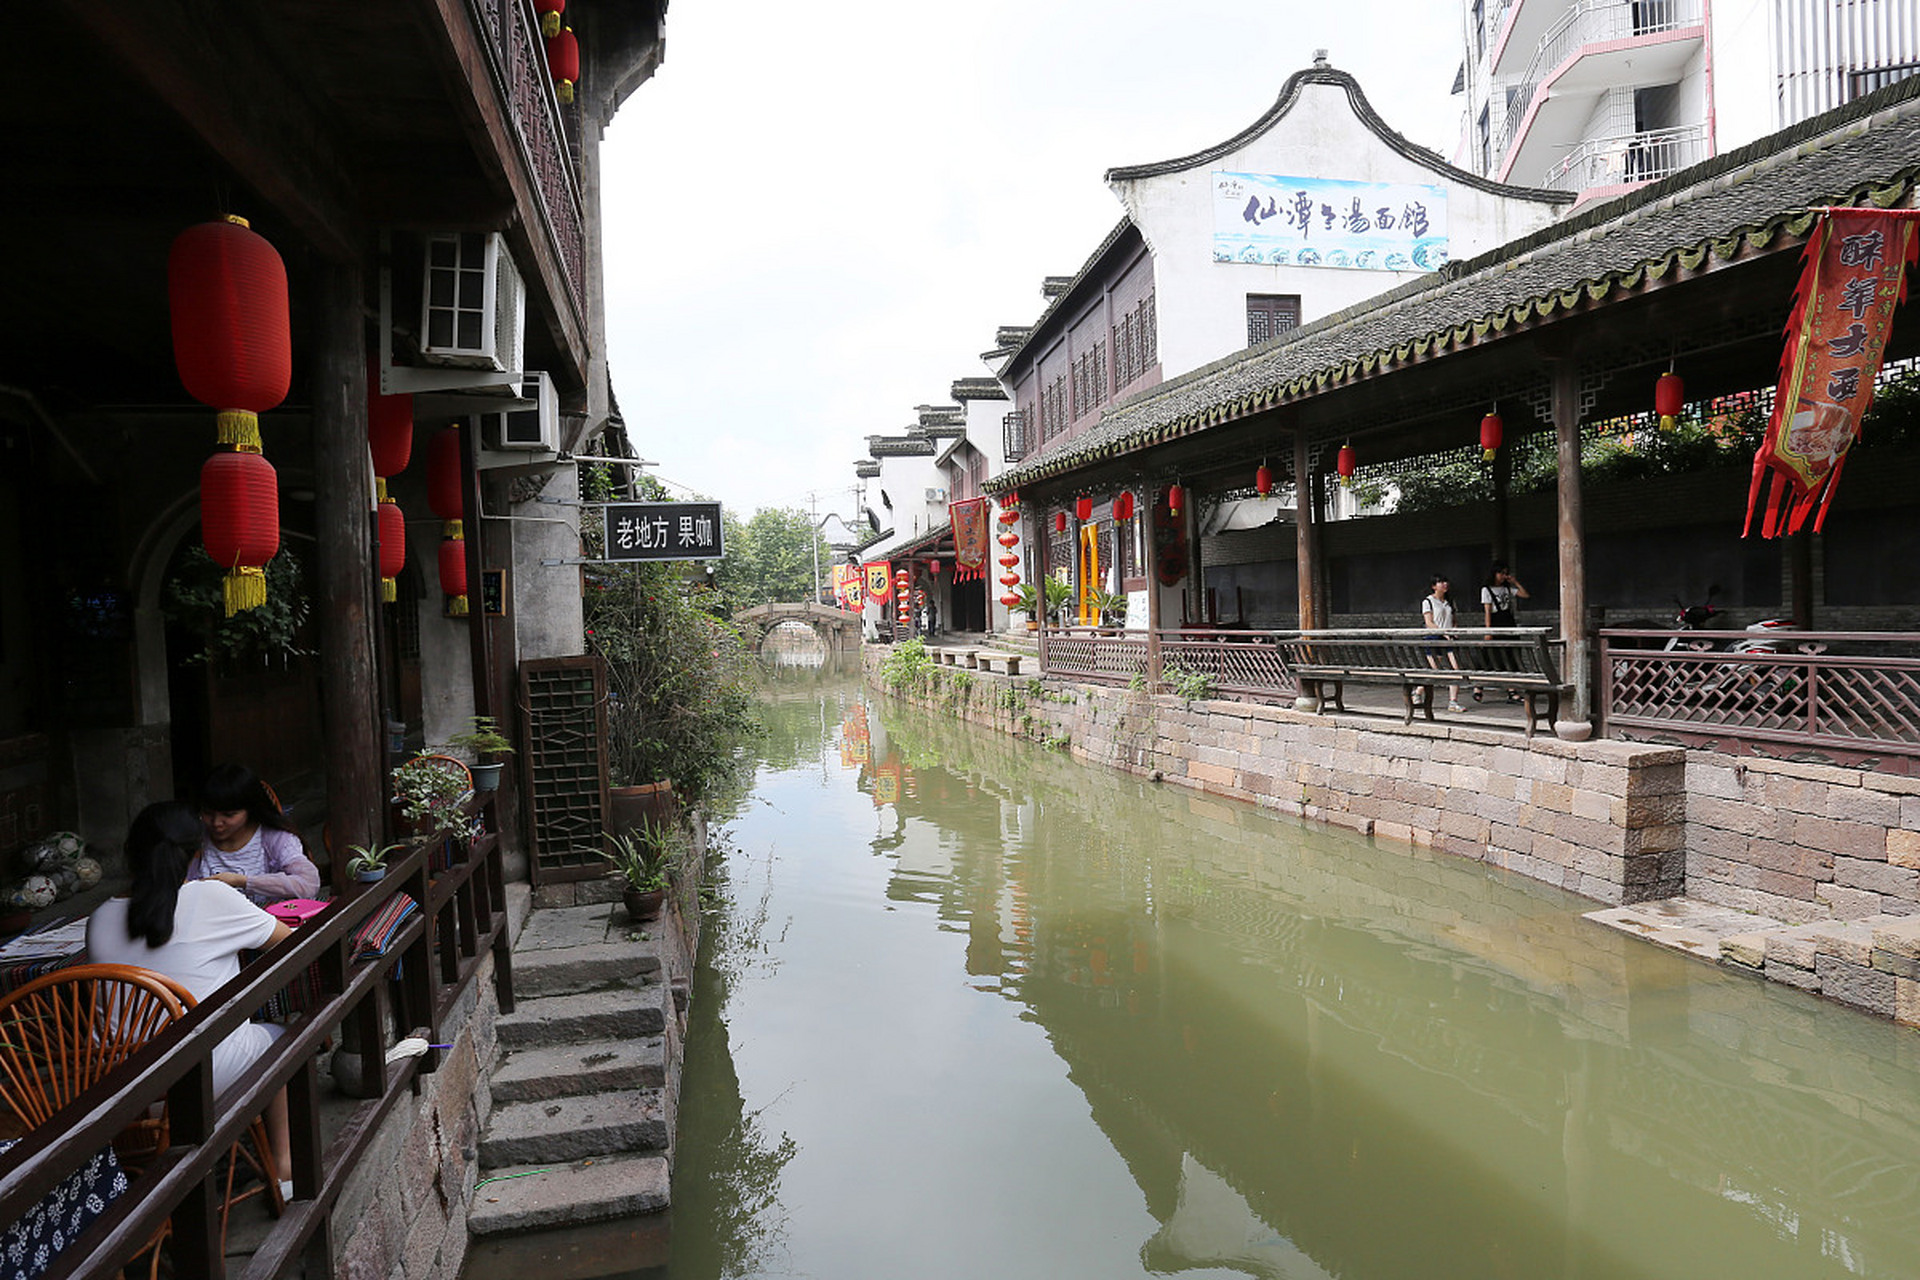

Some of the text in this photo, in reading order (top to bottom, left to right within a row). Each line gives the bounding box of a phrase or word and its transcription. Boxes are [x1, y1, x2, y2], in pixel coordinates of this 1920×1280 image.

[617, 514, 713, 549] 老地方 果咖
